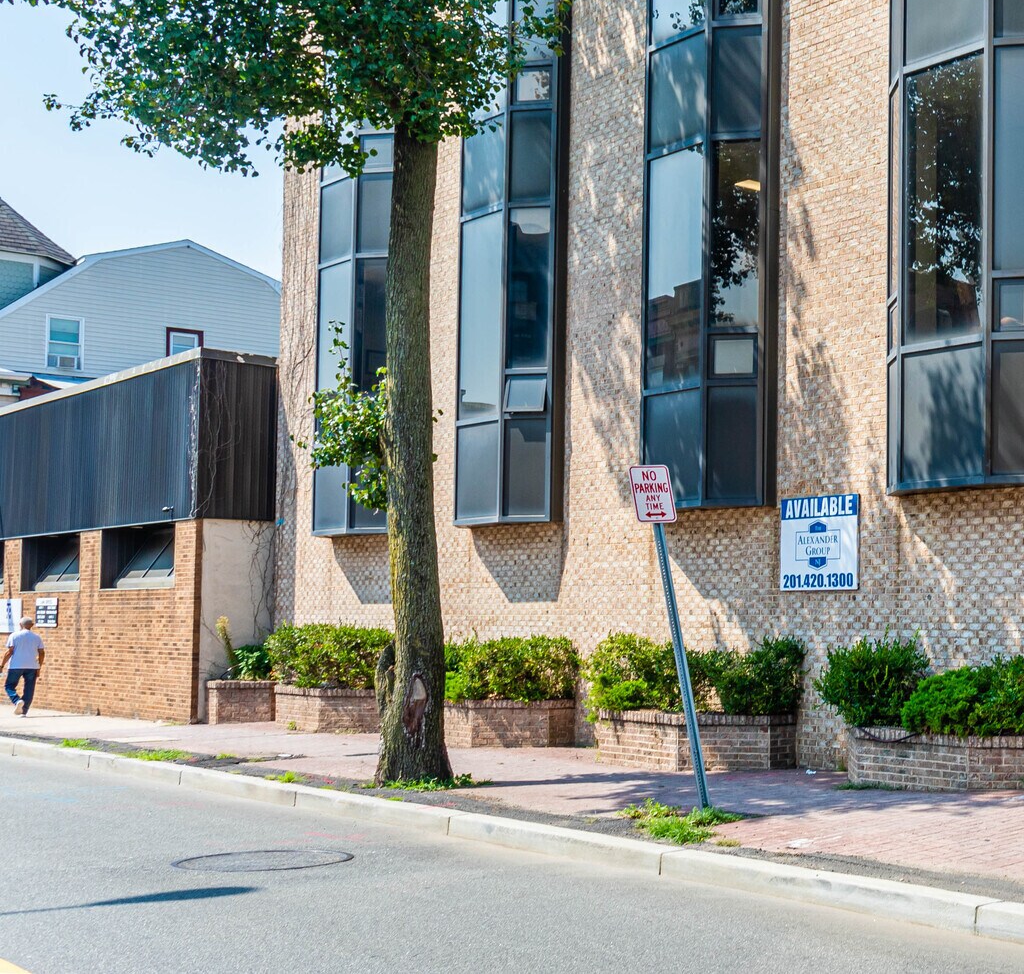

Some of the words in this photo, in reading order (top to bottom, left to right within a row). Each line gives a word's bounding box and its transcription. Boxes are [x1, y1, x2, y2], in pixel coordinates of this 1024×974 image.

[642, 471, 656, 481] NO
[635, 483, 668, 493] PARKING
[785, 495, 853, 518] AVAILABLE
[783, 573, 854, 588] 201.420.1300
